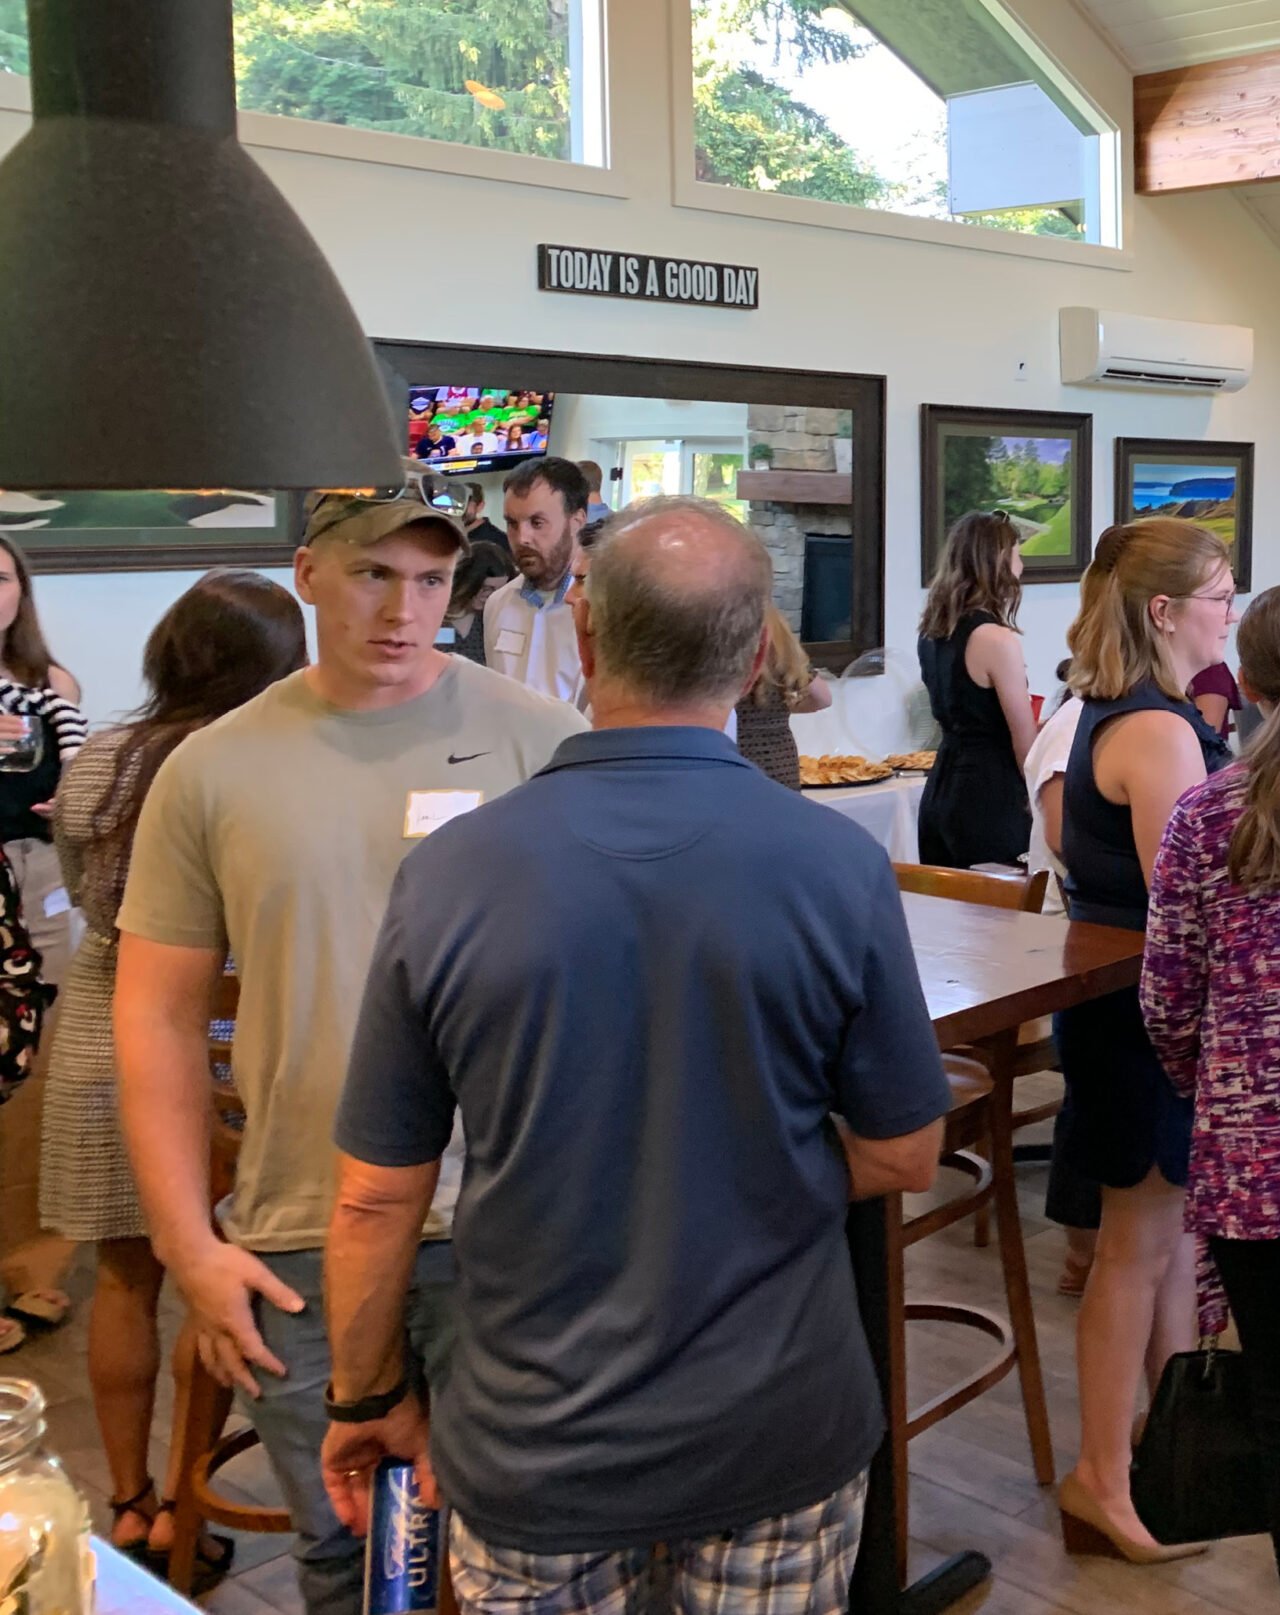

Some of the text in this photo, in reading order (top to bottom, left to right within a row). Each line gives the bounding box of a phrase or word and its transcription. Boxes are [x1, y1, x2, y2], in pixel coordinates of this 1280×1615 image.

[548, 249, 757, 305] TODAY IS A GOOD DAY
